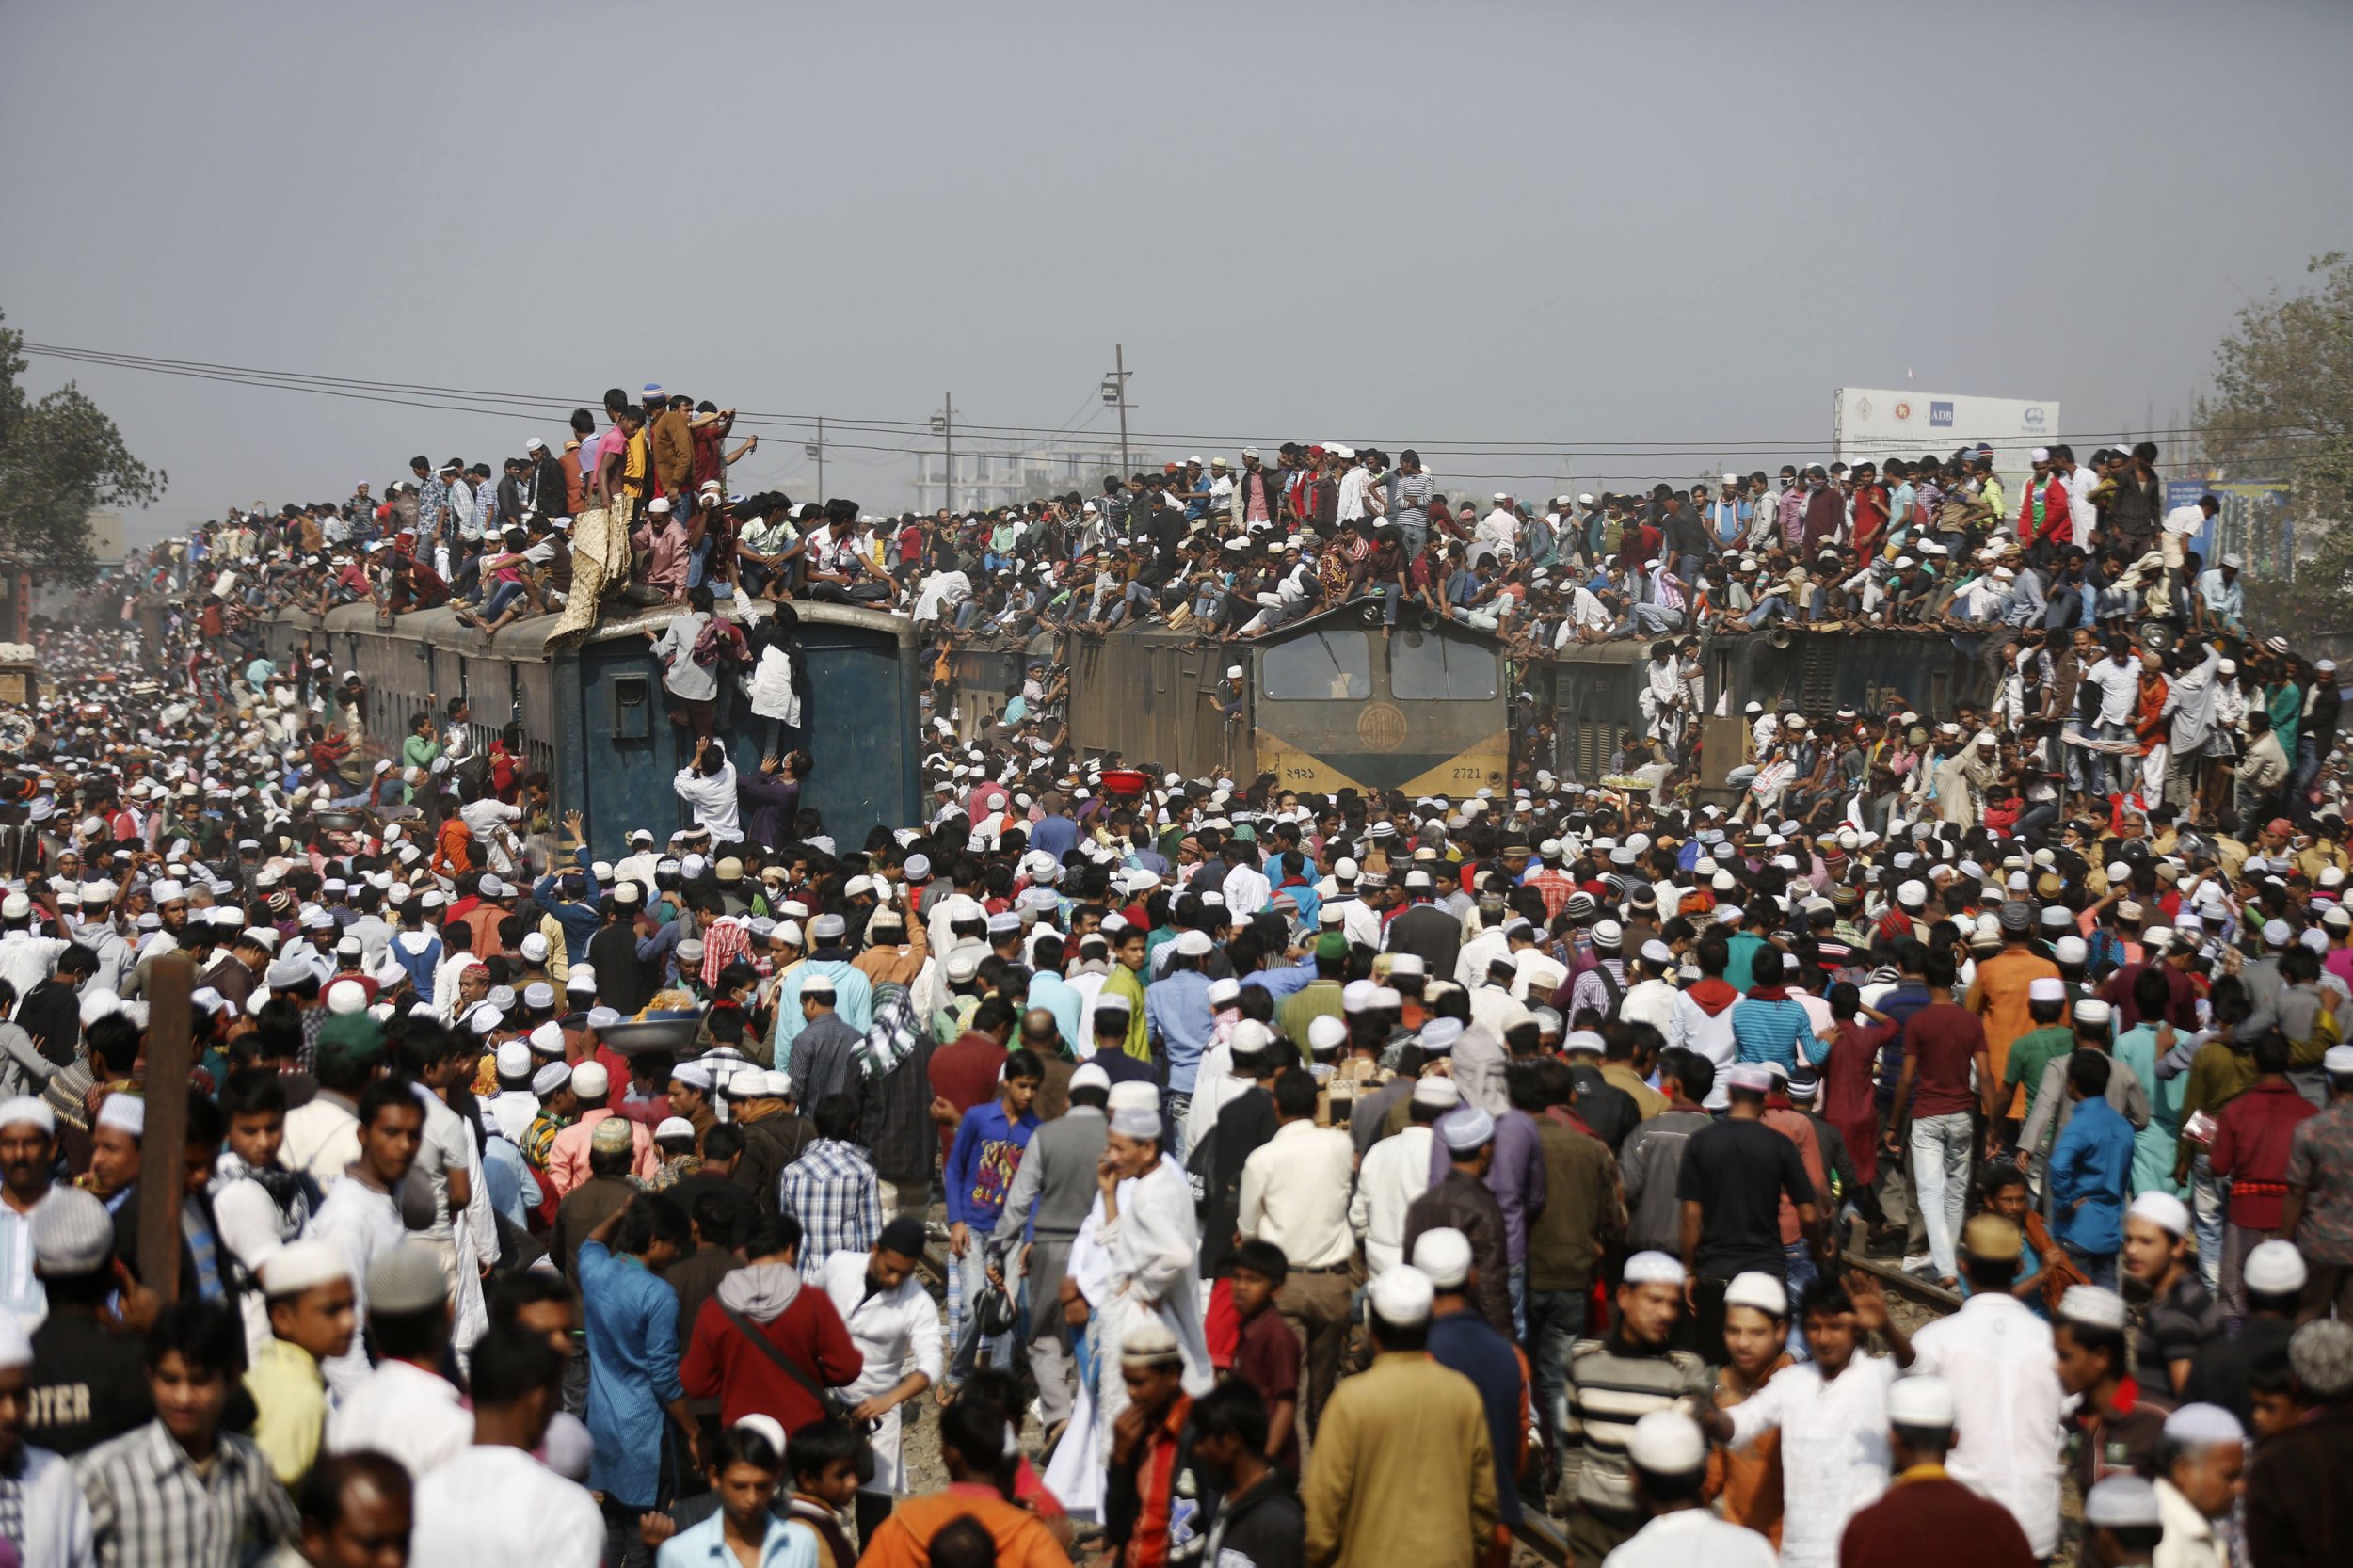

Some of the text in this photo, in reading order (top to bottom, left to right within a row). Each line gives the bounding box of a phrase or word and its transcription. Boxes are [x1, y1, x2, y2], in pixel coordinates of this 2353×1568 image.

[1931, 408, 1952, 421] ADB
[1287, 768, 1315, 779] ২৭২১
[1453, 768, 1481, 779] 2721
